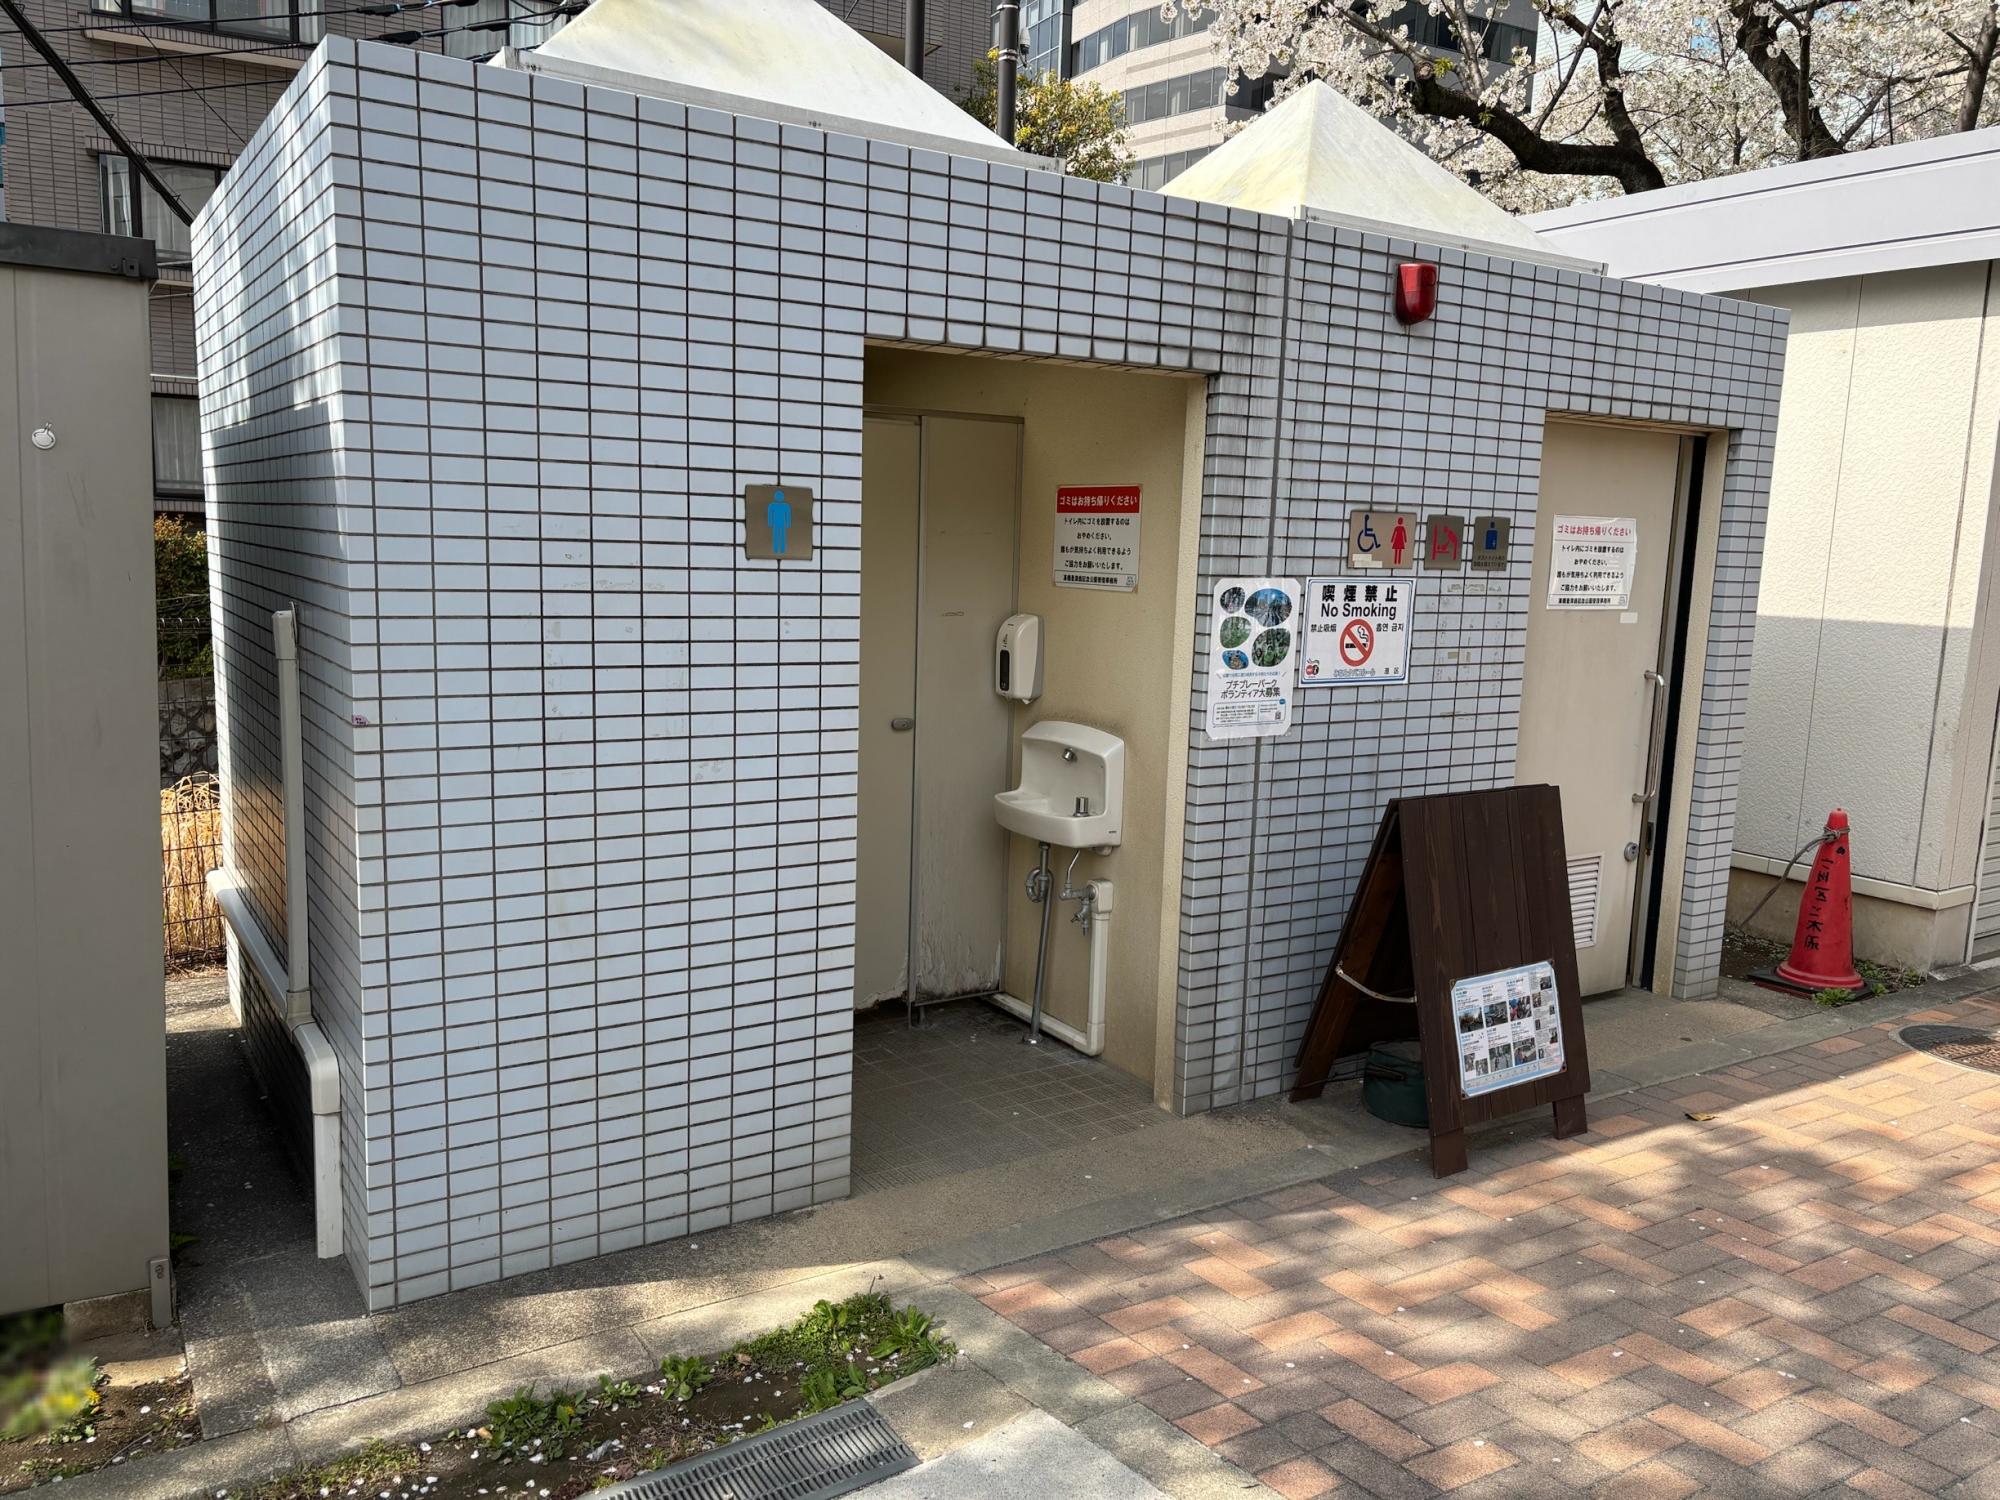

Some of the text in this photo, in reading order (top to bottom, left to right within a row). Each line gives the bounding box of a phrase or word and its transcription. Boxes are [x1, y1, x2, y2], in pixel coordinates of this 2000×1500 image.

[1060, 496, 1137, 507] ゴミはお持ち帰りください
[1064, 517, 1130, 526] トイレ内にゴミを放置するのは
[1557, 525, 1631, 537] ゴミはお持ち帰りください
[1321, 584, 1398, 603] 喫煙禁止
[1321, 602, 1397, 620] No Smoking
[1220, 687, 1281, 700] ボランティア大募集
